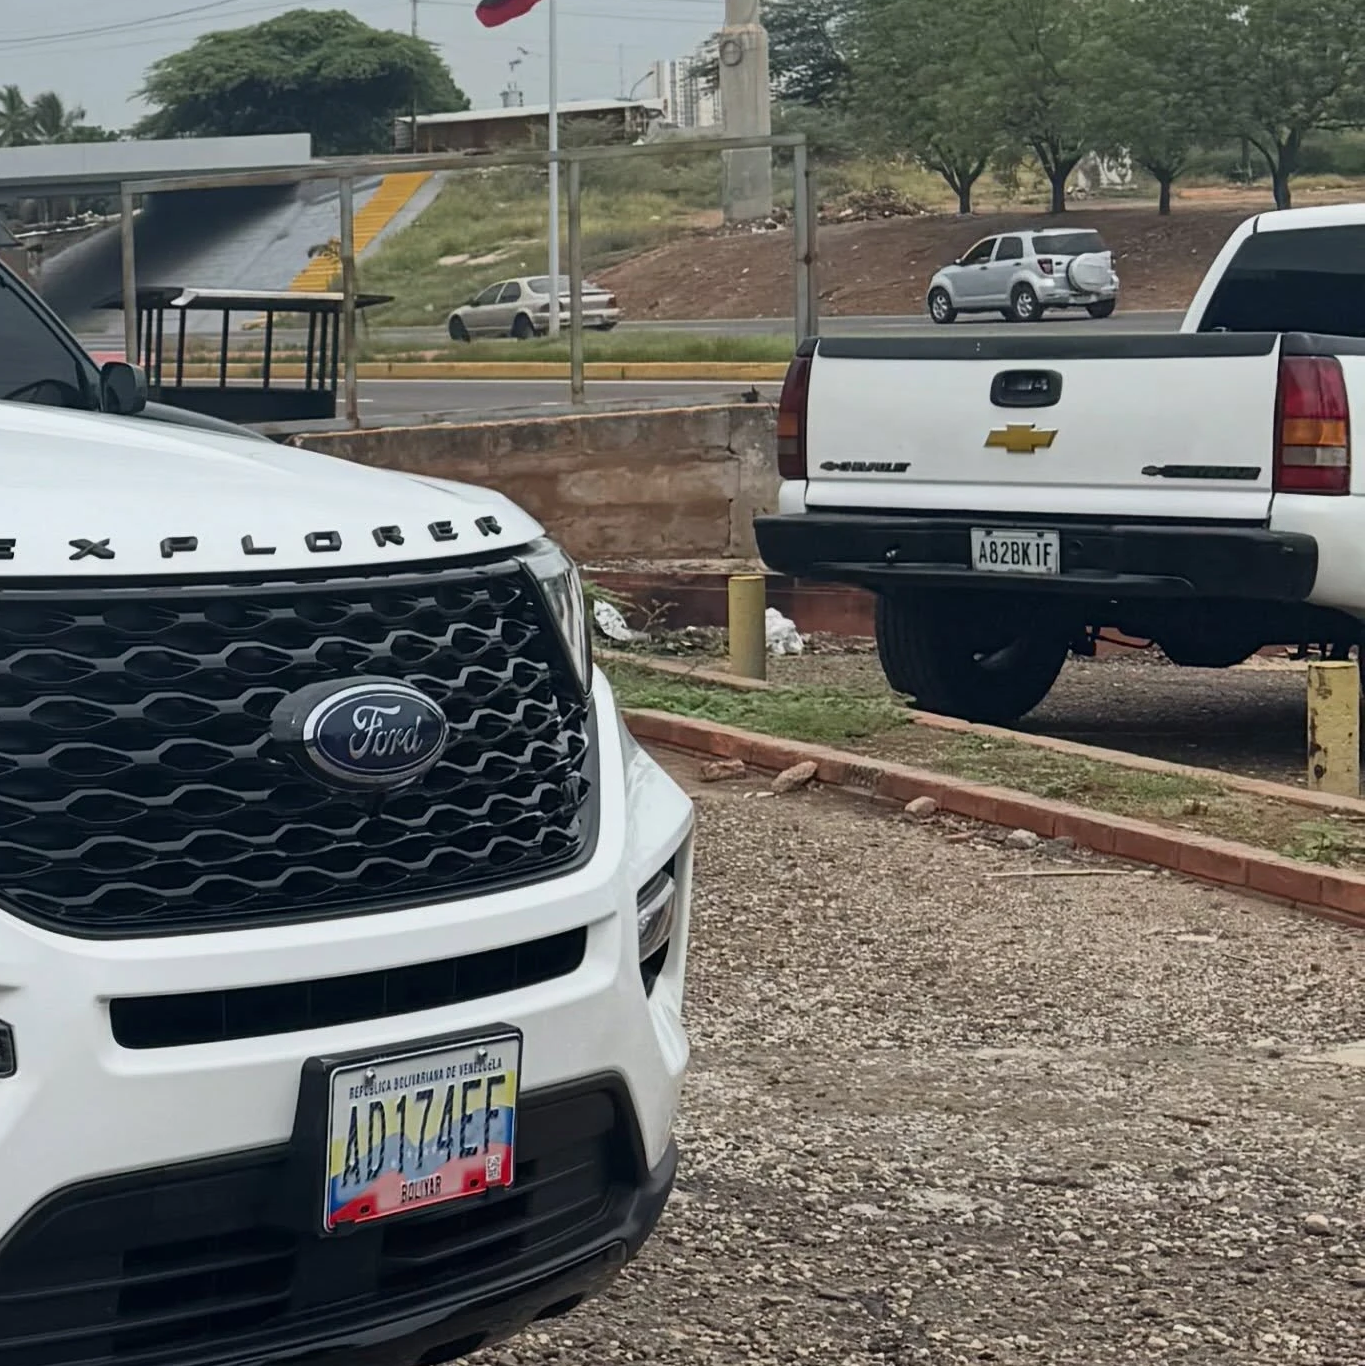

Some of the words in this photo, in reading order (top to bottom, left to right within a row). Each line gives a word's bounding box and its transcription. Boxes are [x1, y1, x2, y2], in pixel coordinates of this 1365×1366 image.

[979, 540, 1053, 567] A82BK1F
[349, 705, 423, 760] Ford
[445, 1065, 457, 1078] DE
[341, 1075, 505, 1188] AD174EF
